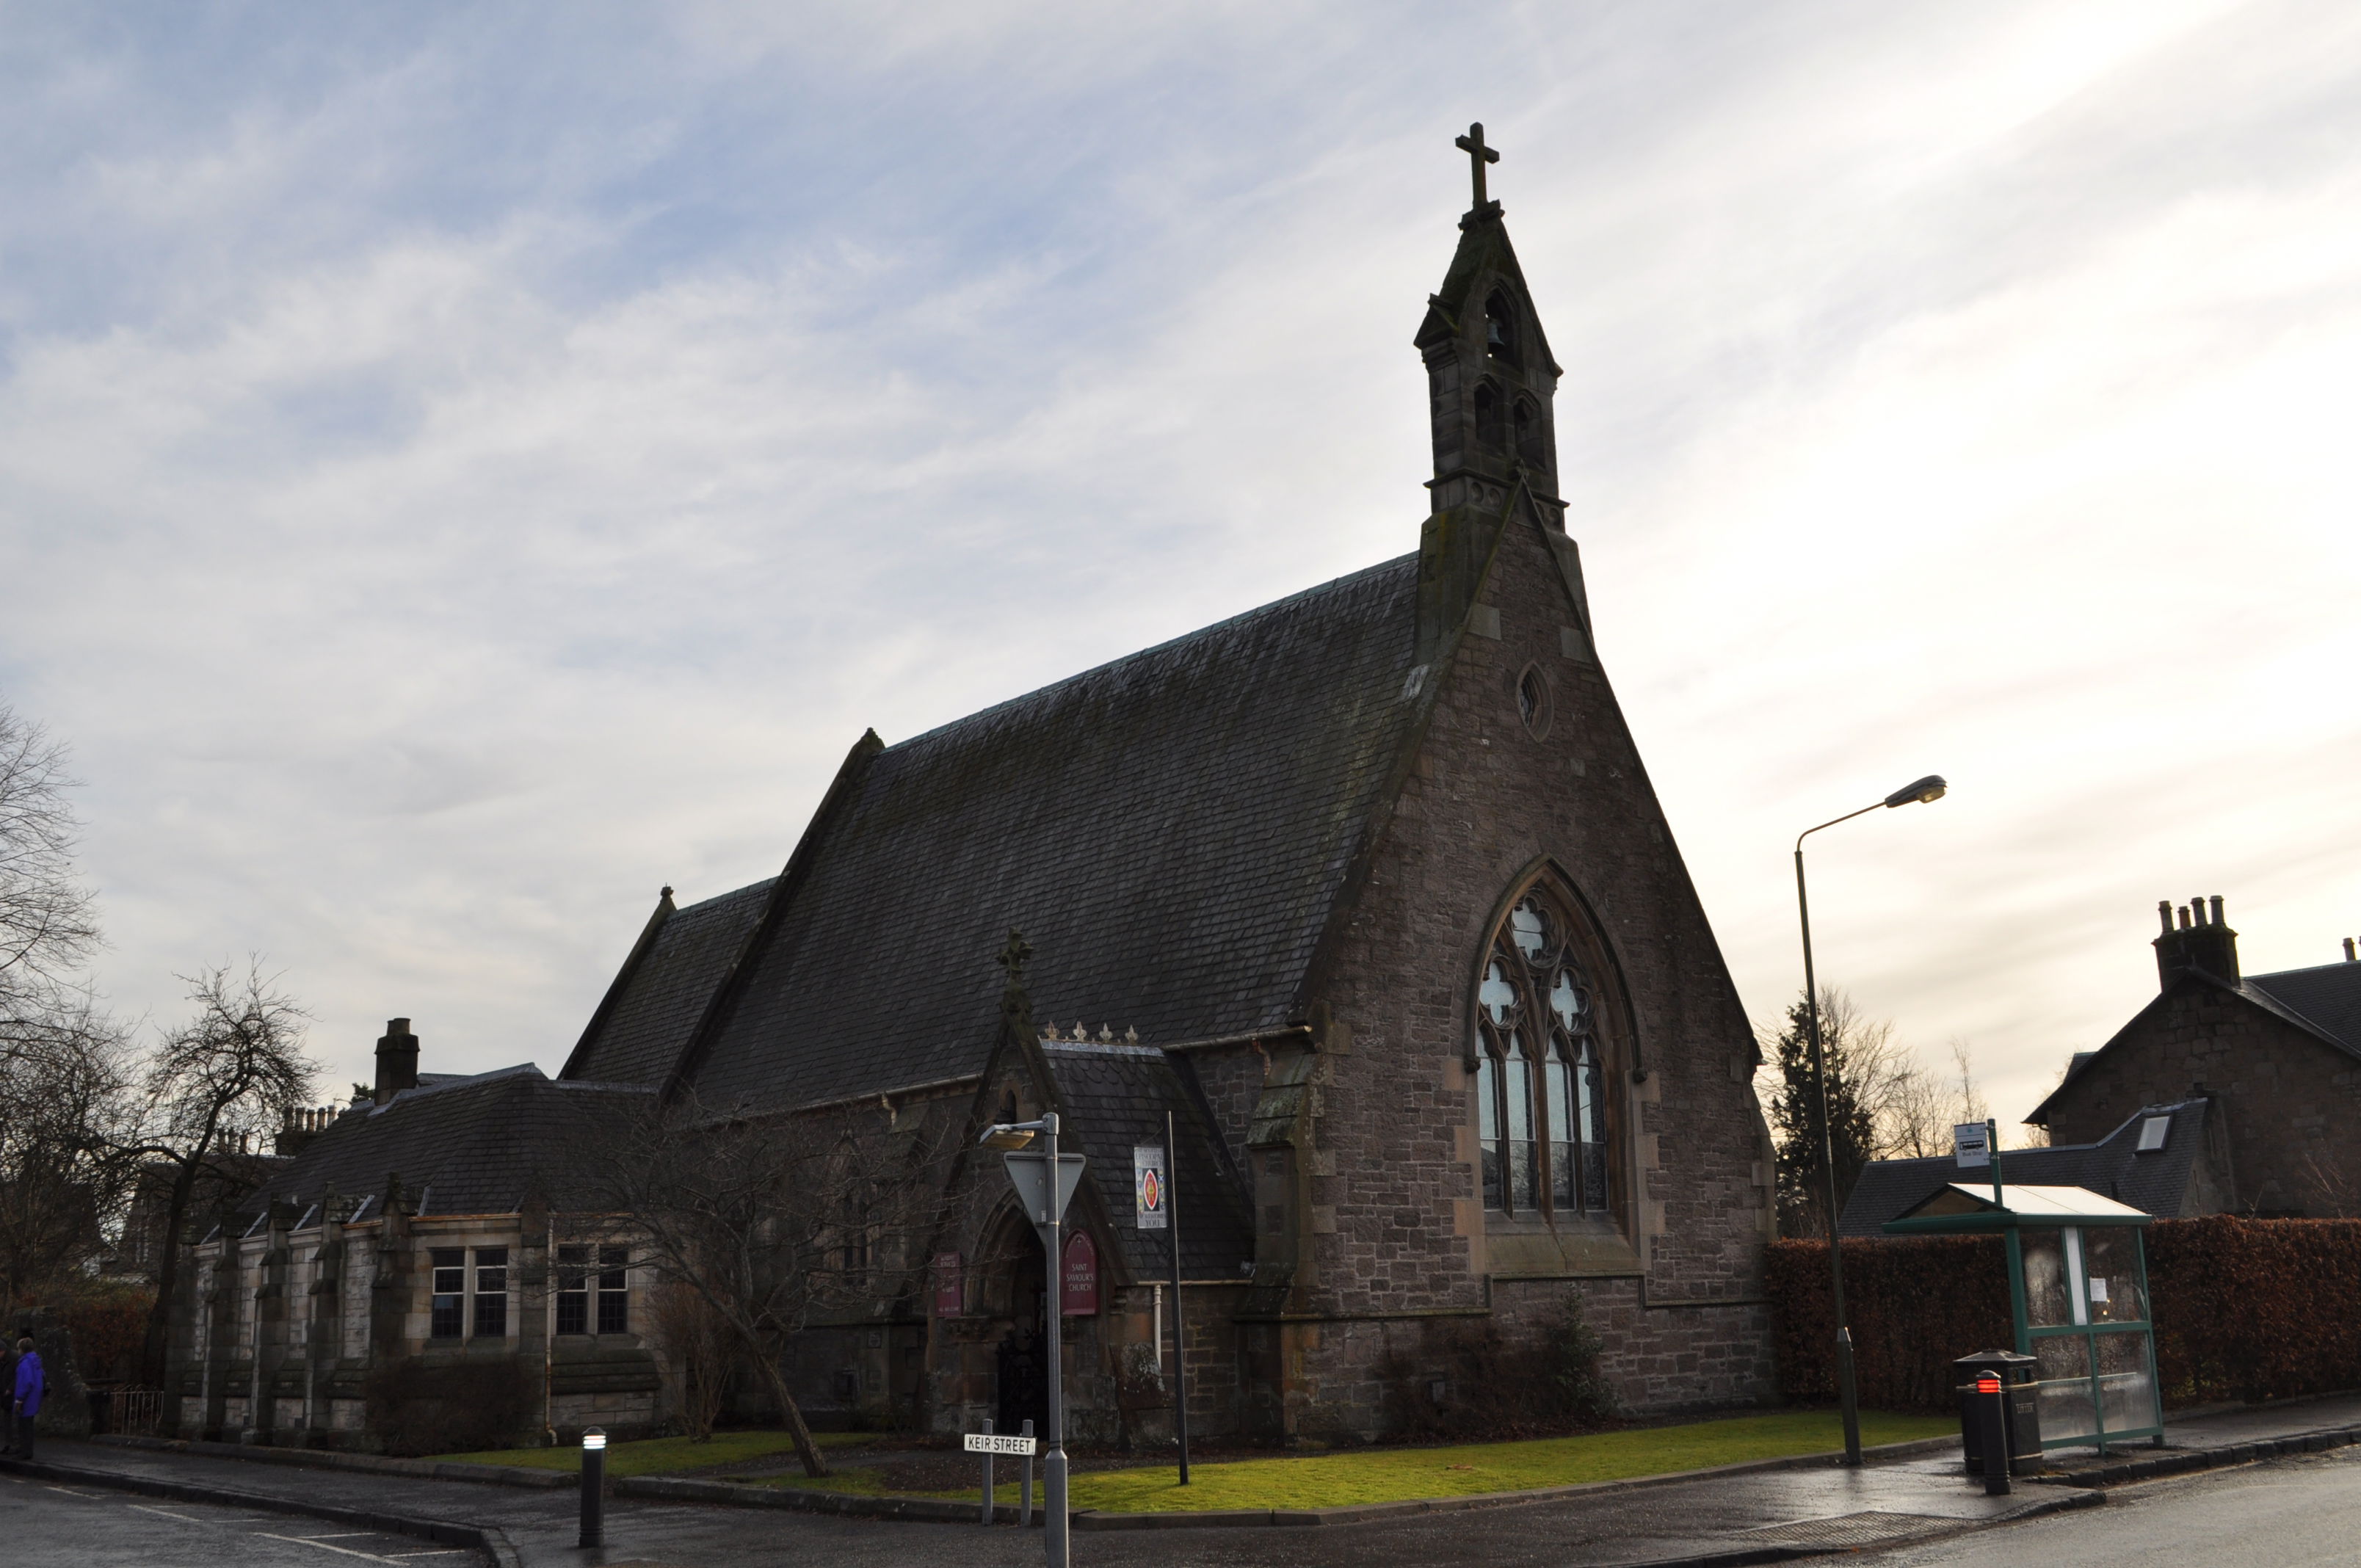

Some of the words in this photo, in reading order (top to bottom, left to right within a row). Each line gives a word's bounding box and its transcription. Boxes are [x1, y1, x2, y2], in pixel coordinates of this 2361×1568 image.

[1145, 1219, 1160, 1227] YOU
[1072, 1263, 1087, 1271] SAINT
[1066, 1274, 1094, 1282] SAVIOUR'S
[1069, 1284, 1092, 1292] CHURCH
[968, 1437, 990, 1450] KEIR
[994, 1438, 1031, 1453] STREET
